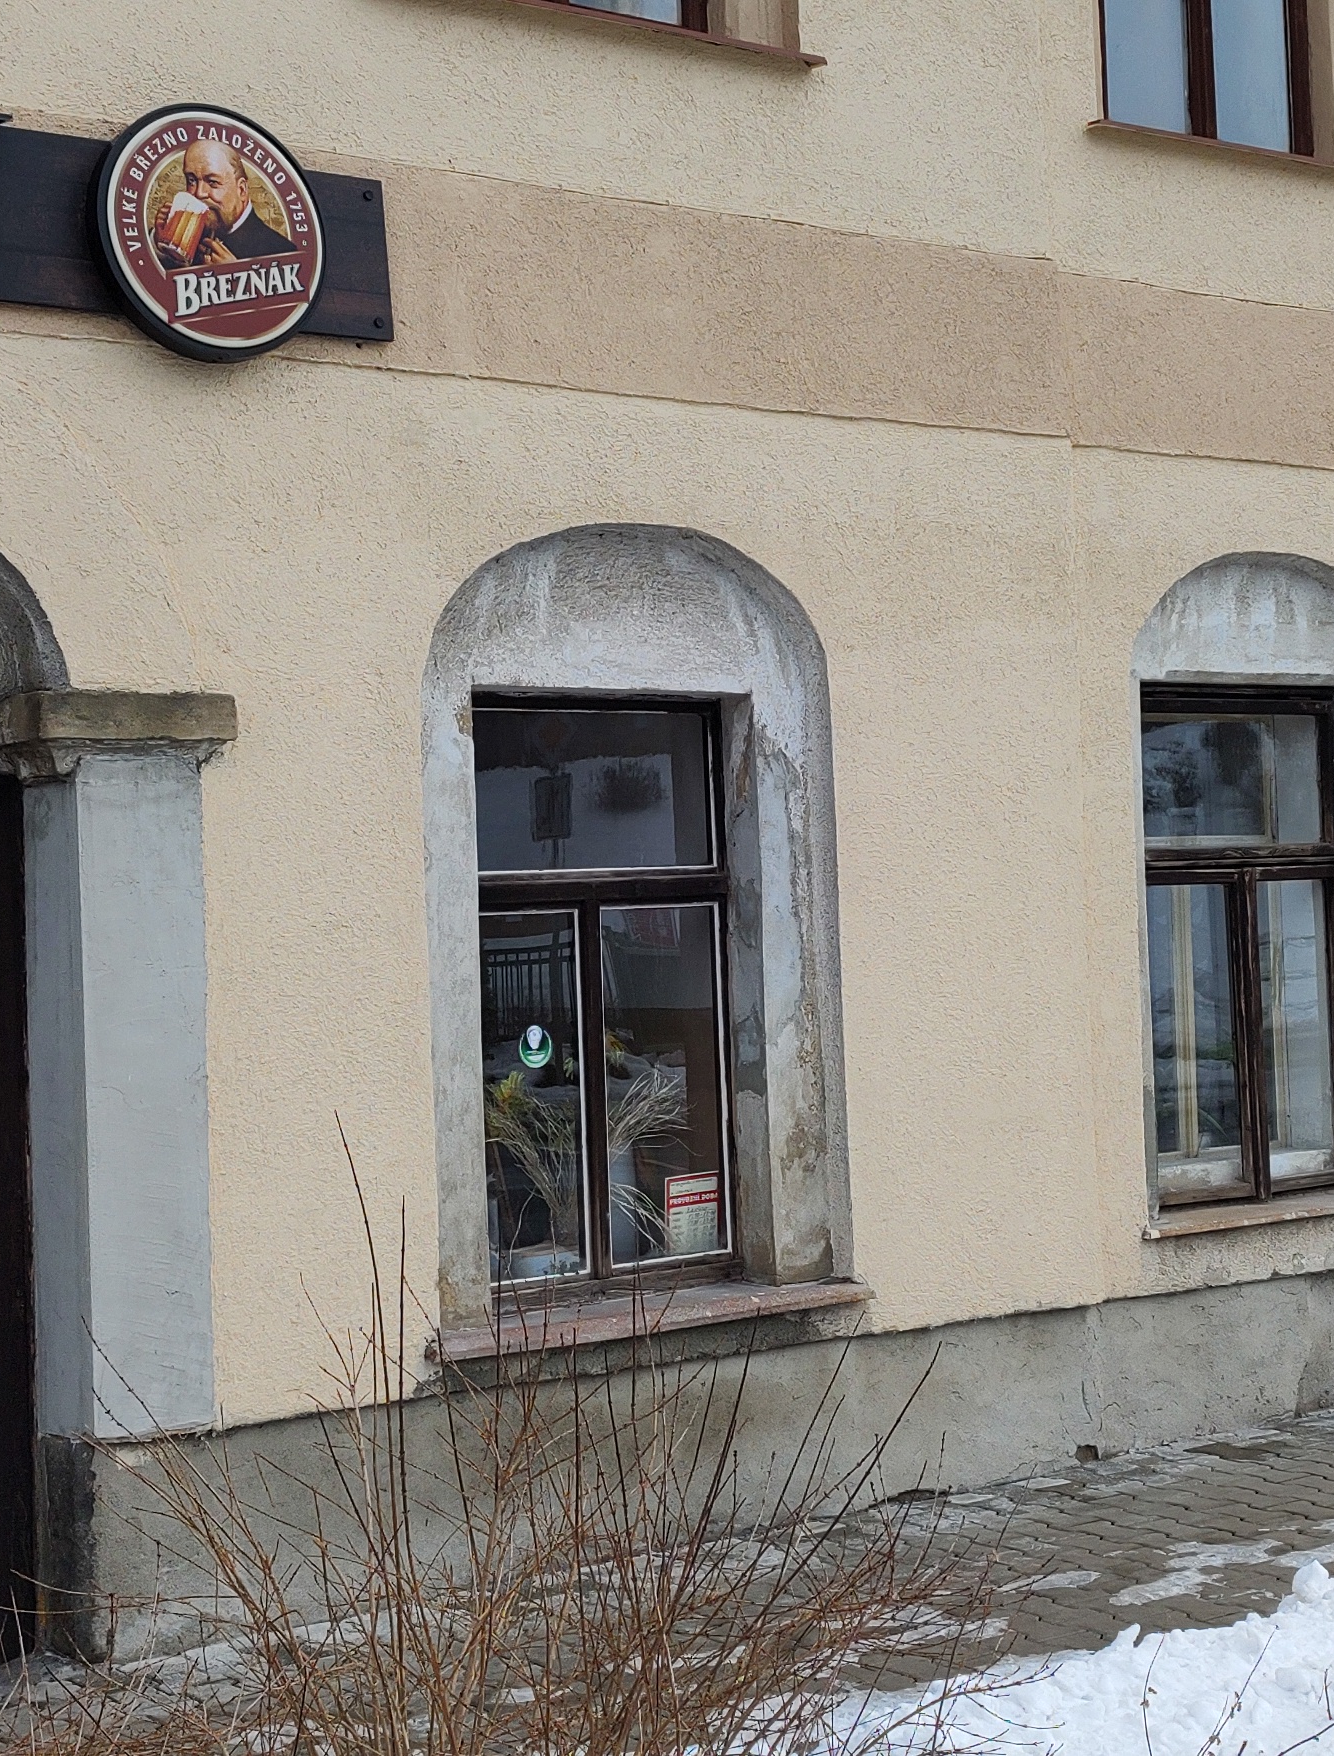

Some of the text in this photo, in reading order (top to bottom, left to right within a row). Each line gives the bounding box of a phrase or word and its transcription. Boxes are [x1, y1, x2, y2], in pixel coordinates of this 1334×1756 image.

[121, 125, 308, 252] VELKÉ BŘEZNO ZALOŽENO 1753
[173, 261, 305, 316] BŘEZŇÁK
